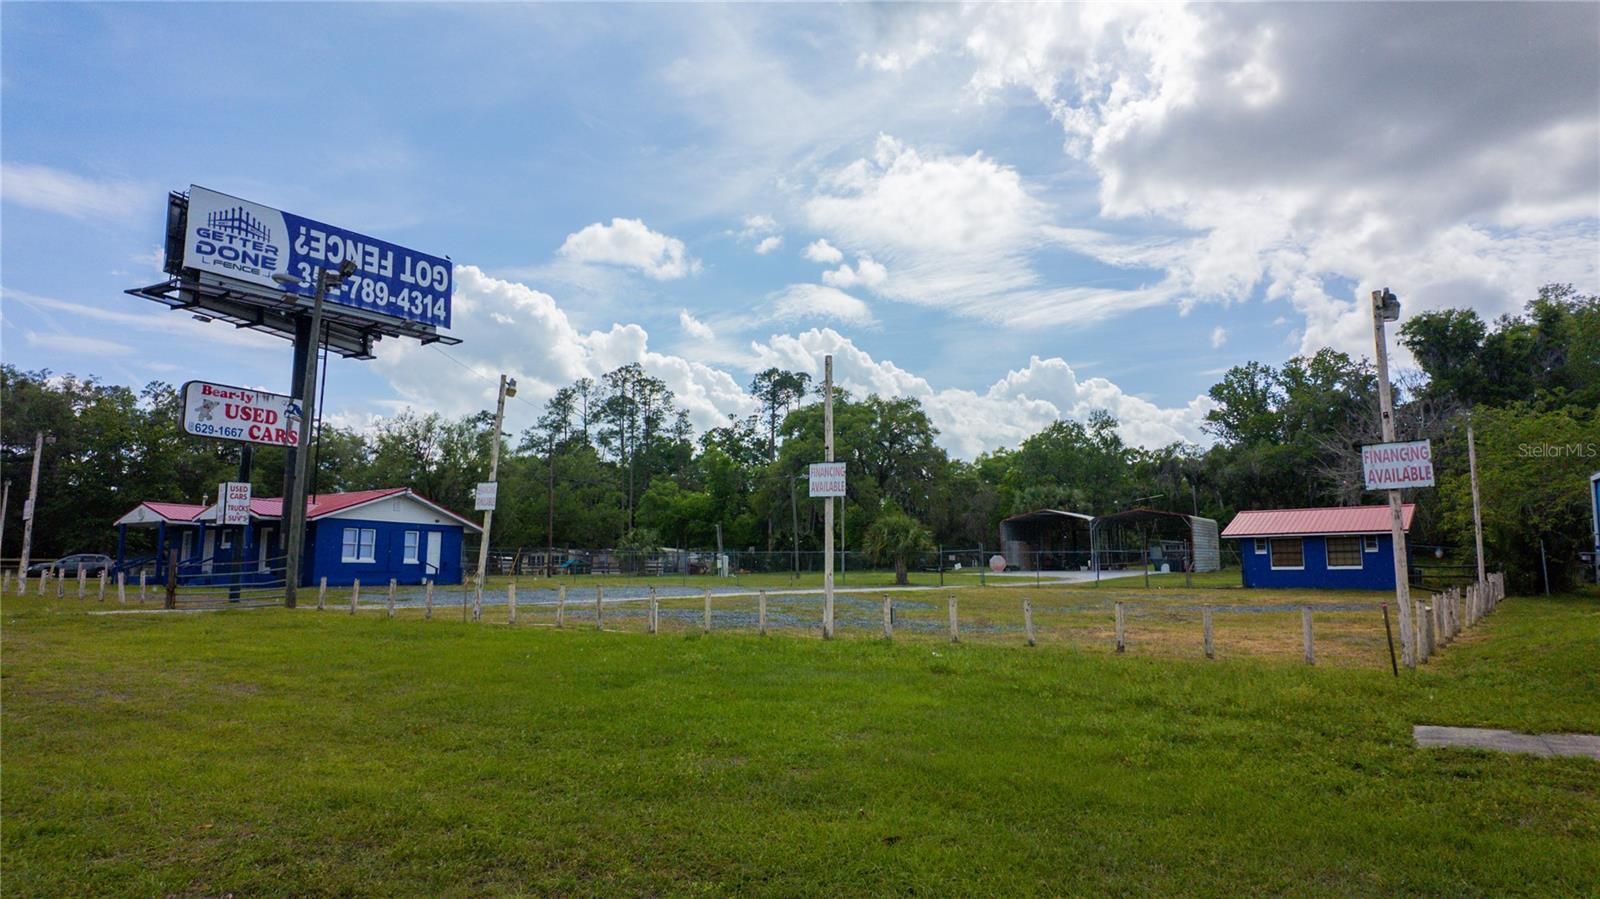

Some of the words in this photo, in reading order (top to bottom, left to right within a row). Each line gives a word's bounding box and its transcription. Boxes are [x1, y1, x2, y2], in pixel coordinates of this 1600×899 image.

[196, 227, 279, 257] GETTER
[195, 240, 278, 271] DONE
[294, 225, 394, 279] FENCE?
[213, 259, 261, 276] FENCE
[400, 256, 449, 293] GOT
[201, 384, 255, 404] Bear-ly
[225, 403, 279, 425] USED
[194, 423, 244, 438] 629-1667
[248, 425, 298, 445] CARS
[1363, 445, 1430, 464] FINANCING
[1368, 465, 1432, 484] AVAILABLE
[230, 485, 248, 493] USED
[811, 480, 845, 492] AVAILABLE
[230, 492, 248, 500] CARS
[227, 504, 251, 512] TRUCKS
